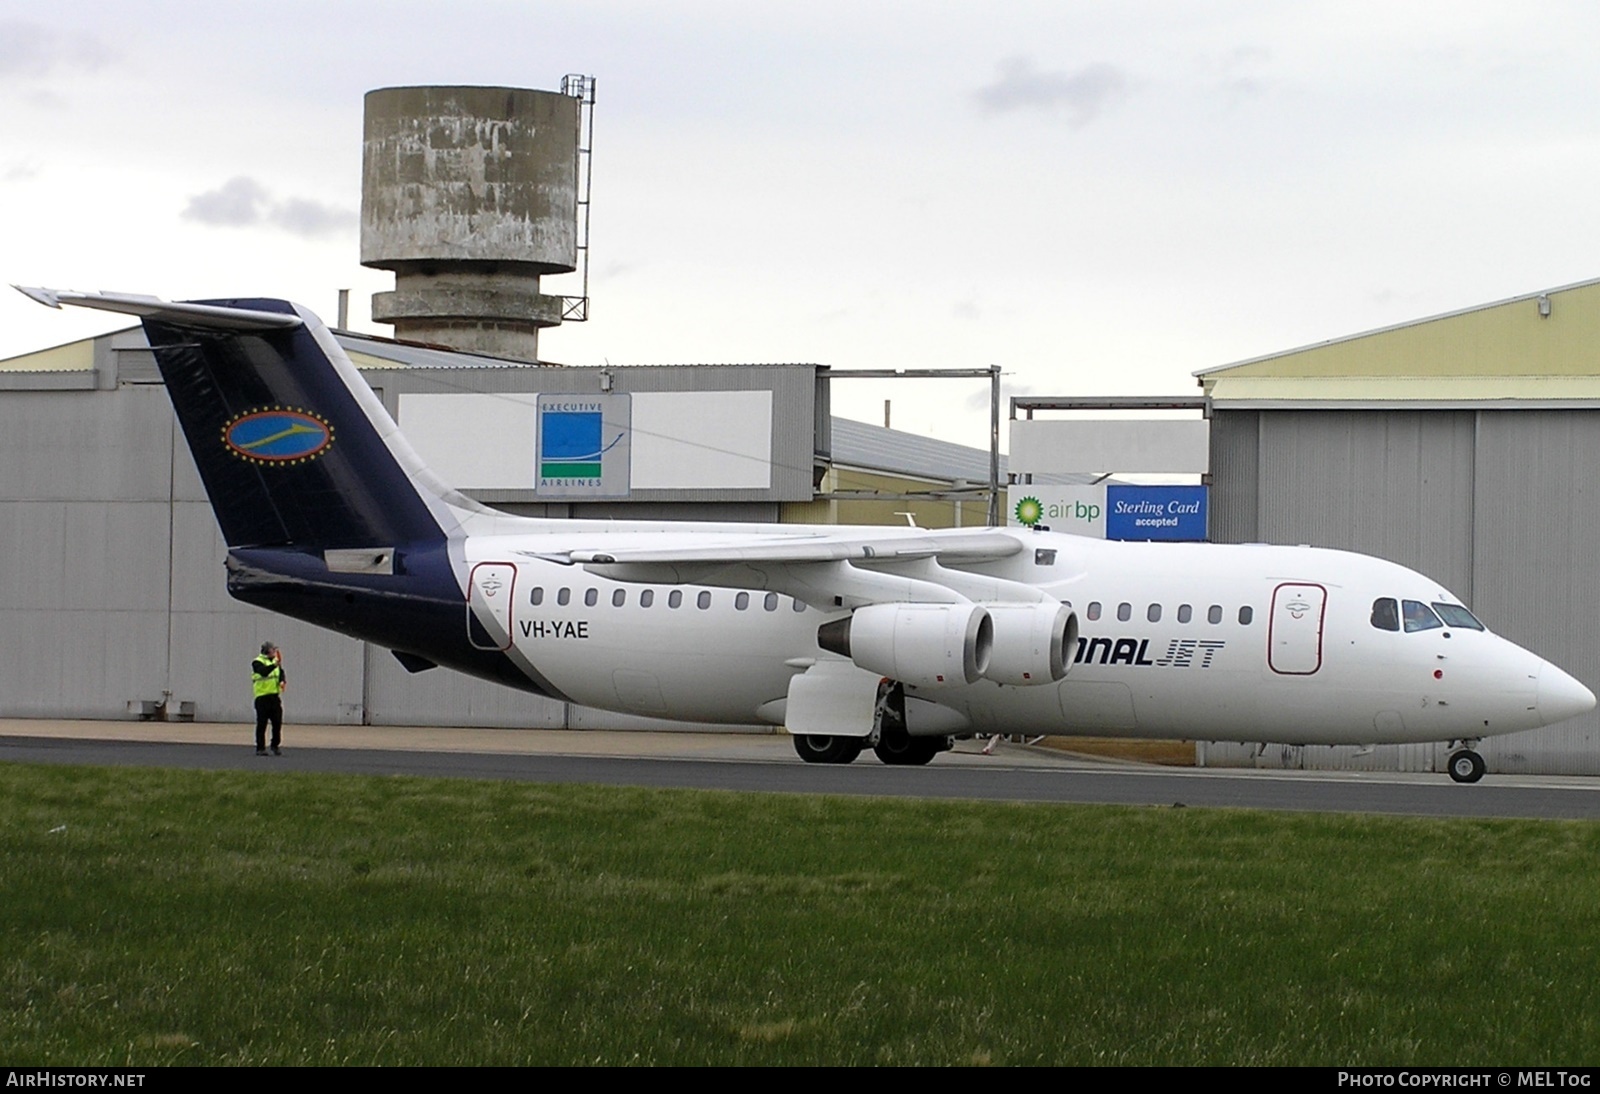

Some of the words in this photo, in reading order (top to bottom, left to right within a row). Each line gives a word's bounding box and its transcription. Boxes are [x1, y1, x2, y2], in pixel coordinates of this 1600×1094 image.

[542, 403, 602, 411] EXECUTIVE
[541, 479, 602, 487] AIRLINES
[1115, 501, 1163, 516] Sterling
[1168, 501, 1200, 514] Card
[1136, 517, 1178, 527] accepted
[520, 620, 589, 638] VH-YAE
